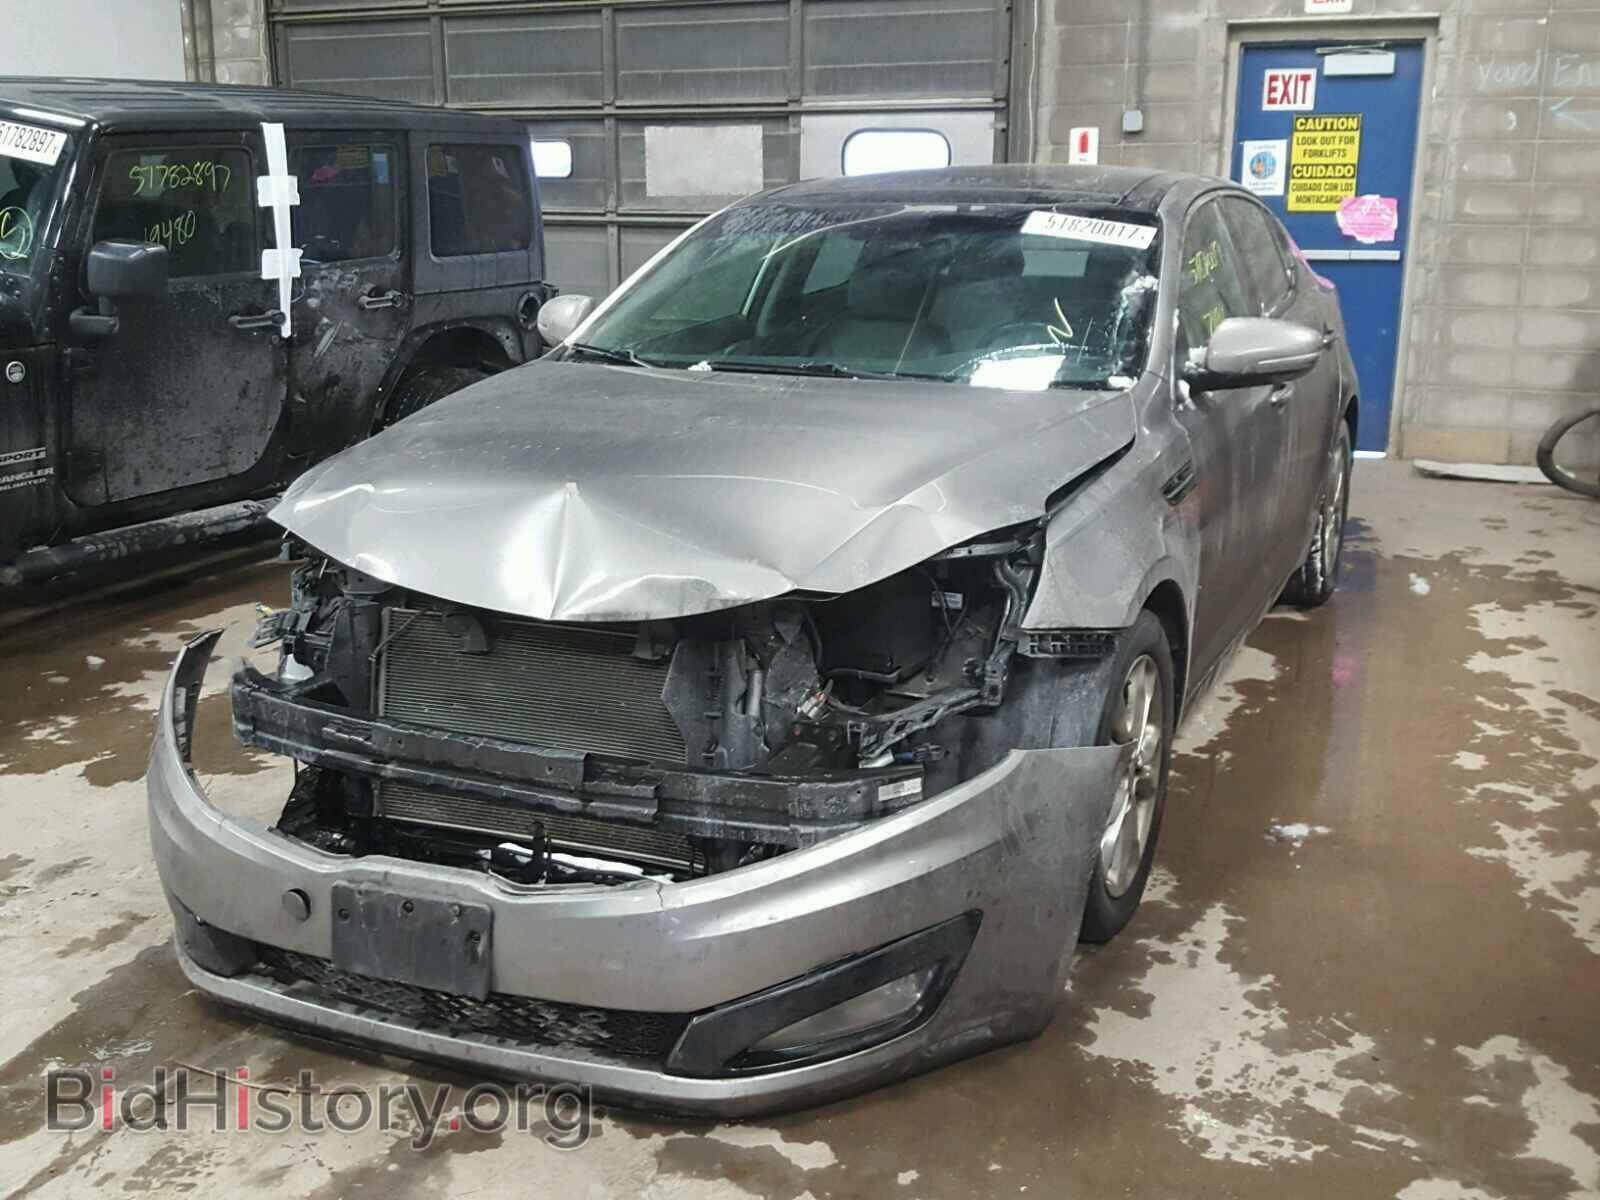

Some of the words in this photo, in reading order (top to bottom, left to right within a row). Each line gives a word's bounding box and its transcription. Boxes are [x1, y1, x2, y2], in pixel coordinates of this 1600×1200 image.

[1267, 74, 1312, 105] EXIT
[1295, 117, 1358, 131] CAUTION
[1296, 135, 1319, 146] LOOK
[1320, 135, 1337, 145] OUT
[1338, 135, 1356, 145] FOR
[1302, 148, 1348, 158] FORKLIFTS
[129, 160, 231, 195] 51782897
[1292, 165, 1355, 178] CUIDADO
[1291, 182, 1322, 193] CUIDADO
[1323, 182, 1339, 192] CON
[1340, 182, 1354, 192] LOS
[1295, 194, 1344, 204] MONTACARG
